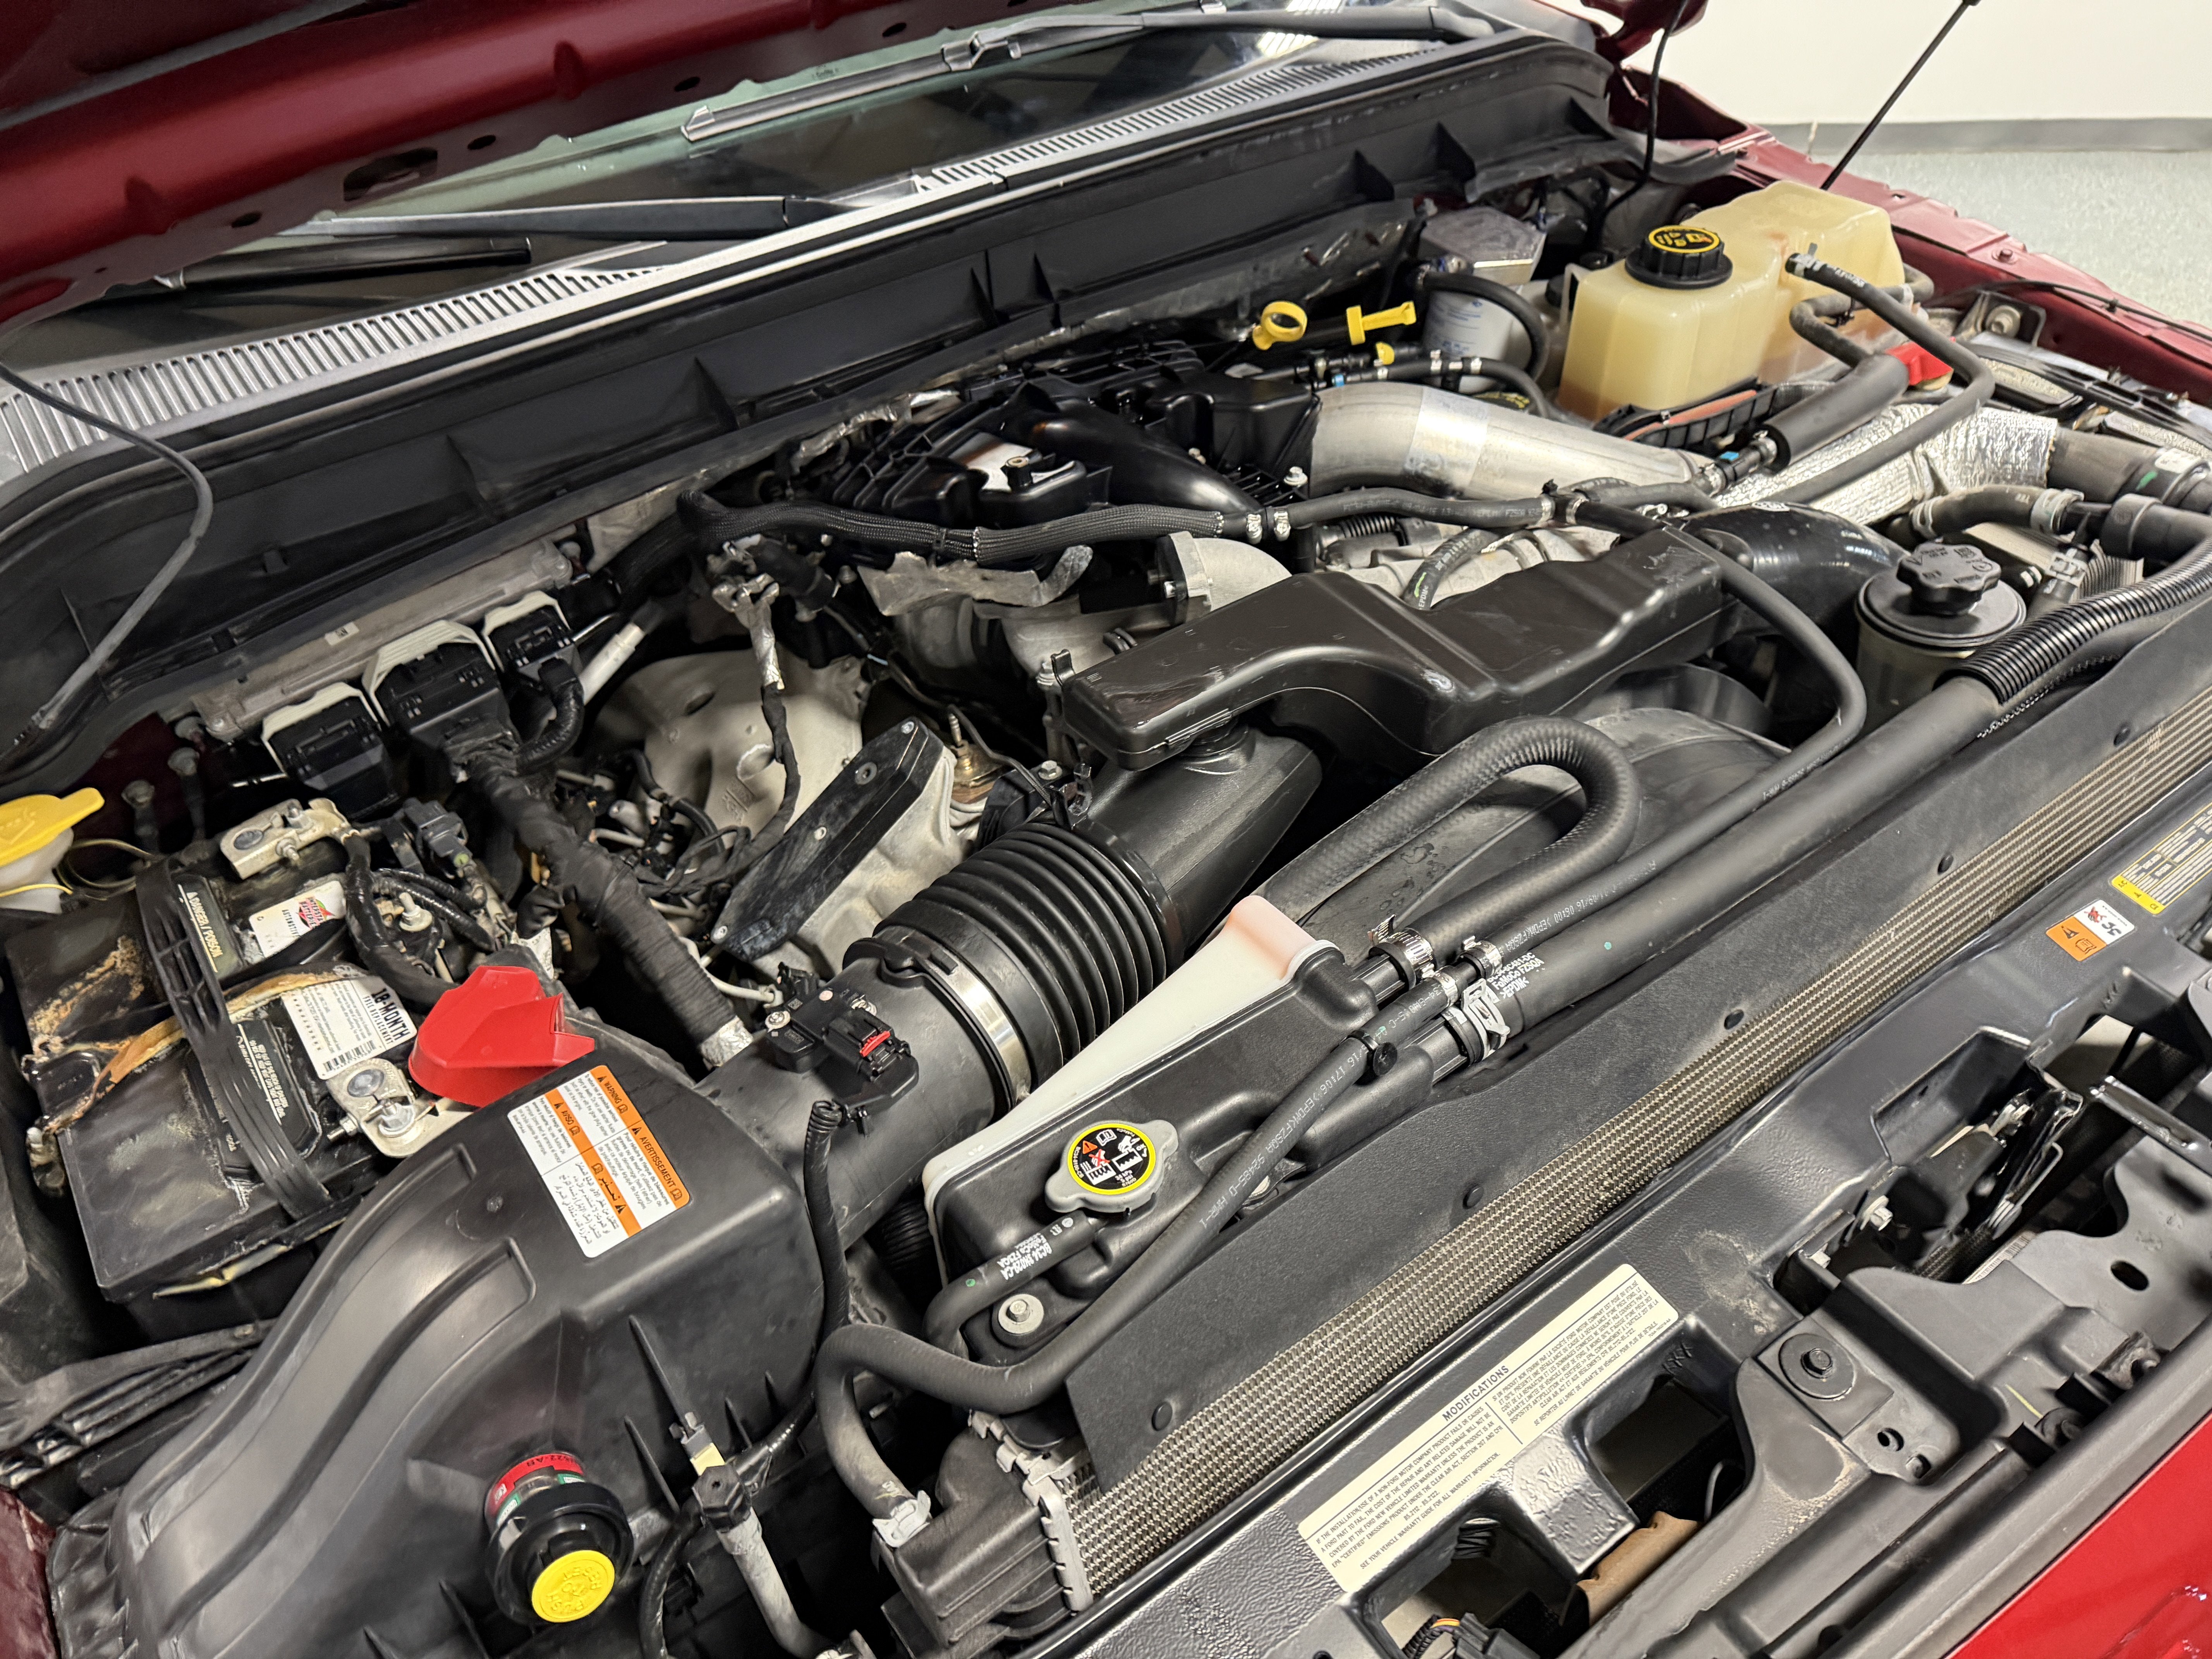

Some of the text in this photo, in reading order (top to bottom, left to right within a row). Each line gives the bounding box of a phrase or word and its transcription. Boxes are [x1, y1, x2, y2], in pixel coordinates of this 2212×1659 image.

[1490, 958, 1544, 989] FoMoCo FZSQA
[623, 1132, 632, 1142] Pour
[641, 1162, 652, 1175] risque
[654, 1182, 669, 1205] blessures
[639, 1136, 676, 1187] AVERTISSEMENT
[1136, 1142, 1146, 1151] OK
[1442, 1365, 1509, 1421] MODIFICATIONS
[1321, 1531, 1331, 1539] THE
[1398, 1463, 1413, 1477] MOTOR
[1413, 1447, 1432, 1465] COMPANY
[1432, 1432, 1451, 1449] PRODUCT
[1450, 1424, 1462, 1434] FAILS
[1467, 1407, 1484, 1420] CAUSES
[1324, 1537, 1337, 1549] FORD
[1336, 1528, 1348, 1539] PART
[1354, 1516, 1366, 1525] FAIL,
[1365, 1507, 1374, 1516] THE
[1373, 1498, 1385, 1509] COST
[1390, 1486, 1400, 1494] THE
[1399, 1474, 1415, 1487] REPAIR
[1414, 1467, 1424, 1476] AND
[1424, 1459, 1432, 1468] ANY
[1432, 1445, 1450, 1461] RELATED
[1449, 1432, 1467, 1447] DAMAGE
[1465, 1424, 1477, 1433] WILL
[1475, 1417, 1484, 1425] NOT
[1329, 1540, 1349, 1557] COVERED
[1354, 1527, 1364, 1536] THE
[1363, 1518, 1376, 1529] FORD
[1375, 1510, 1386, 1520] NEW
[1385, 1496, 1403, 1511] VEHICLE
[1401, 1482, 1419, 1498] LIMITED
[1441, 1451, 1457, 1465] UNLESS
[1456, 1444, 1465, 1453] THE
[1464, 1429, 1483, 1446] PRODUCT
[1332, 1559, 1341, 1568] EPA
[1389, 1503, 1408, 1520] PRODUCT
[1408, 1491, 1423, 1504] UNDER
[1422, 1484, 1431, 1492] THE
[1430, 1473, 1444, 1486] CLEAN
[1444, 1467, 1452, 1475] AIR
[1451, 1460, 1462, 1469] ACT,
[1460, 1446, 1478, 1461] SECTION
[1477, 1439, 1486, 1448] 207
[1486, 1432, 1494, 1441] AND
[1360, 1560, 1369, 1569] SEE
[1368, 1550, 1381, 1561] YOUR
[1380, 1536, 1398, 1551] VEHICLE
[1420, 1506, 1434, 1518] GUIDE
[1432, 1499, 1443, 1508] FOR
[1442, 1493, 1451, 1501] ALL
